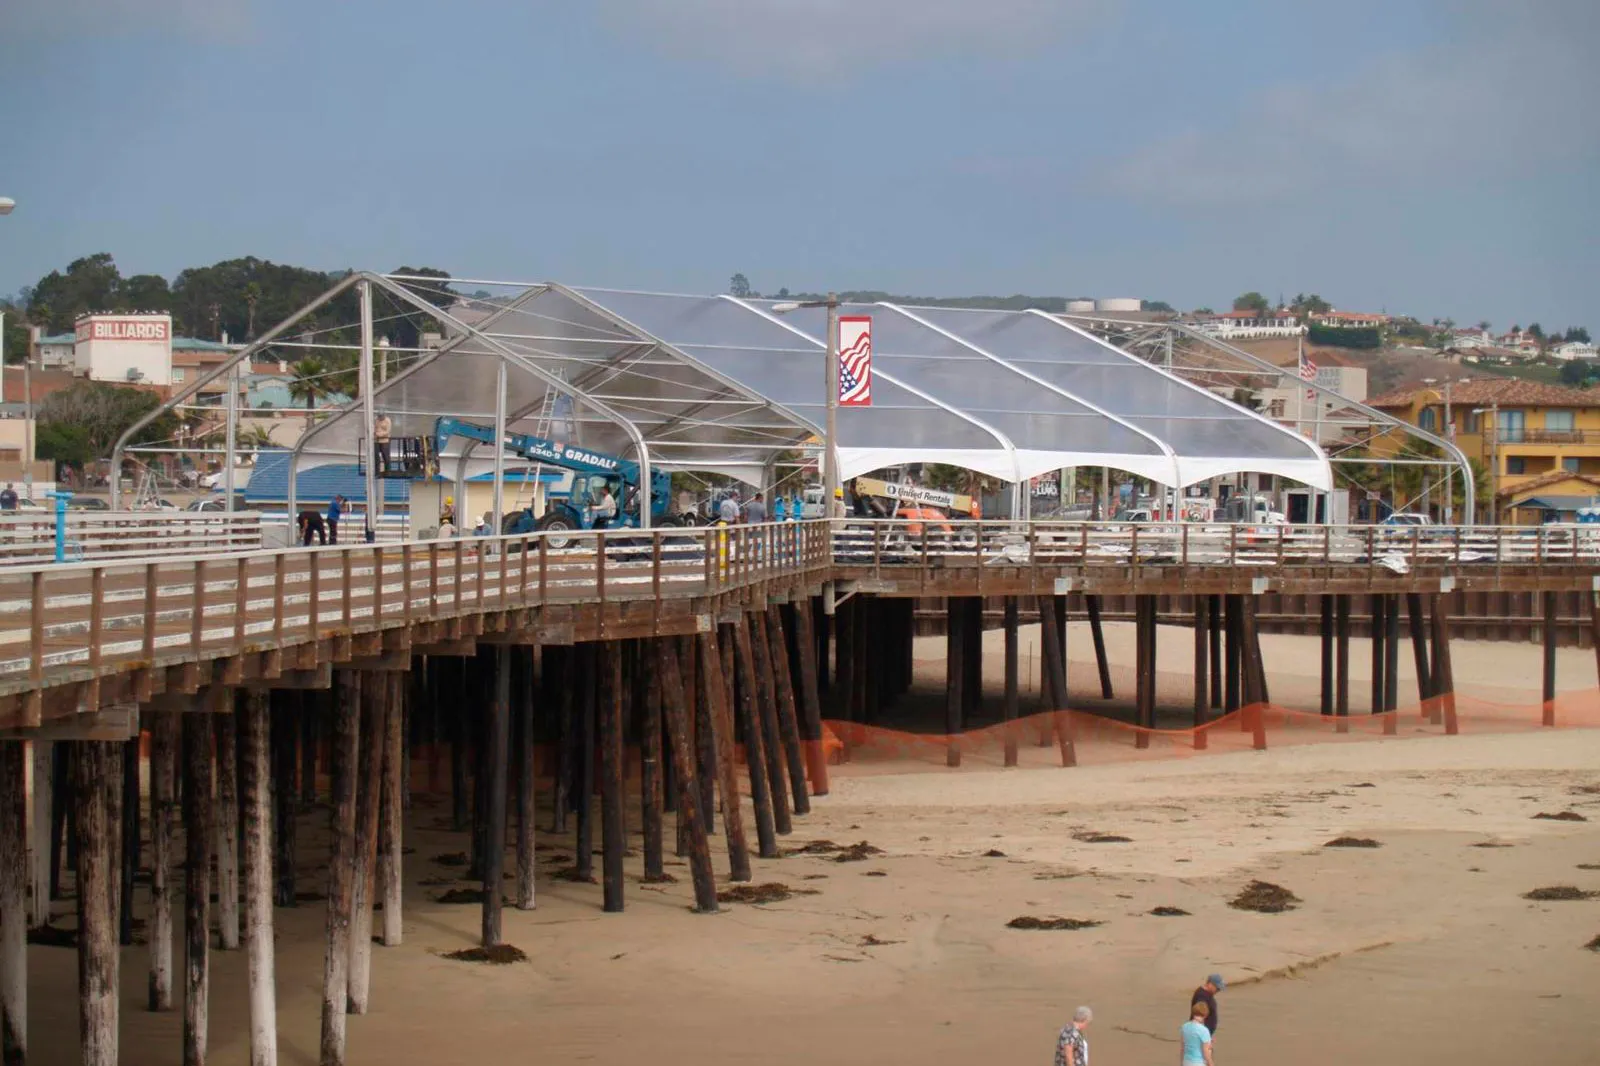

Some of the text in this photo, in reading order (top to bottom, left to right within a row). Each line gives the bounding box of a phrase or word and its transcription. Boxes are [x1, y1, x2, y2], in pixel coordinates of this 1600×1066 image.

[95, 323, 165, 337] BILLIARDS
[898, 487, 950, 504] United Rentals
